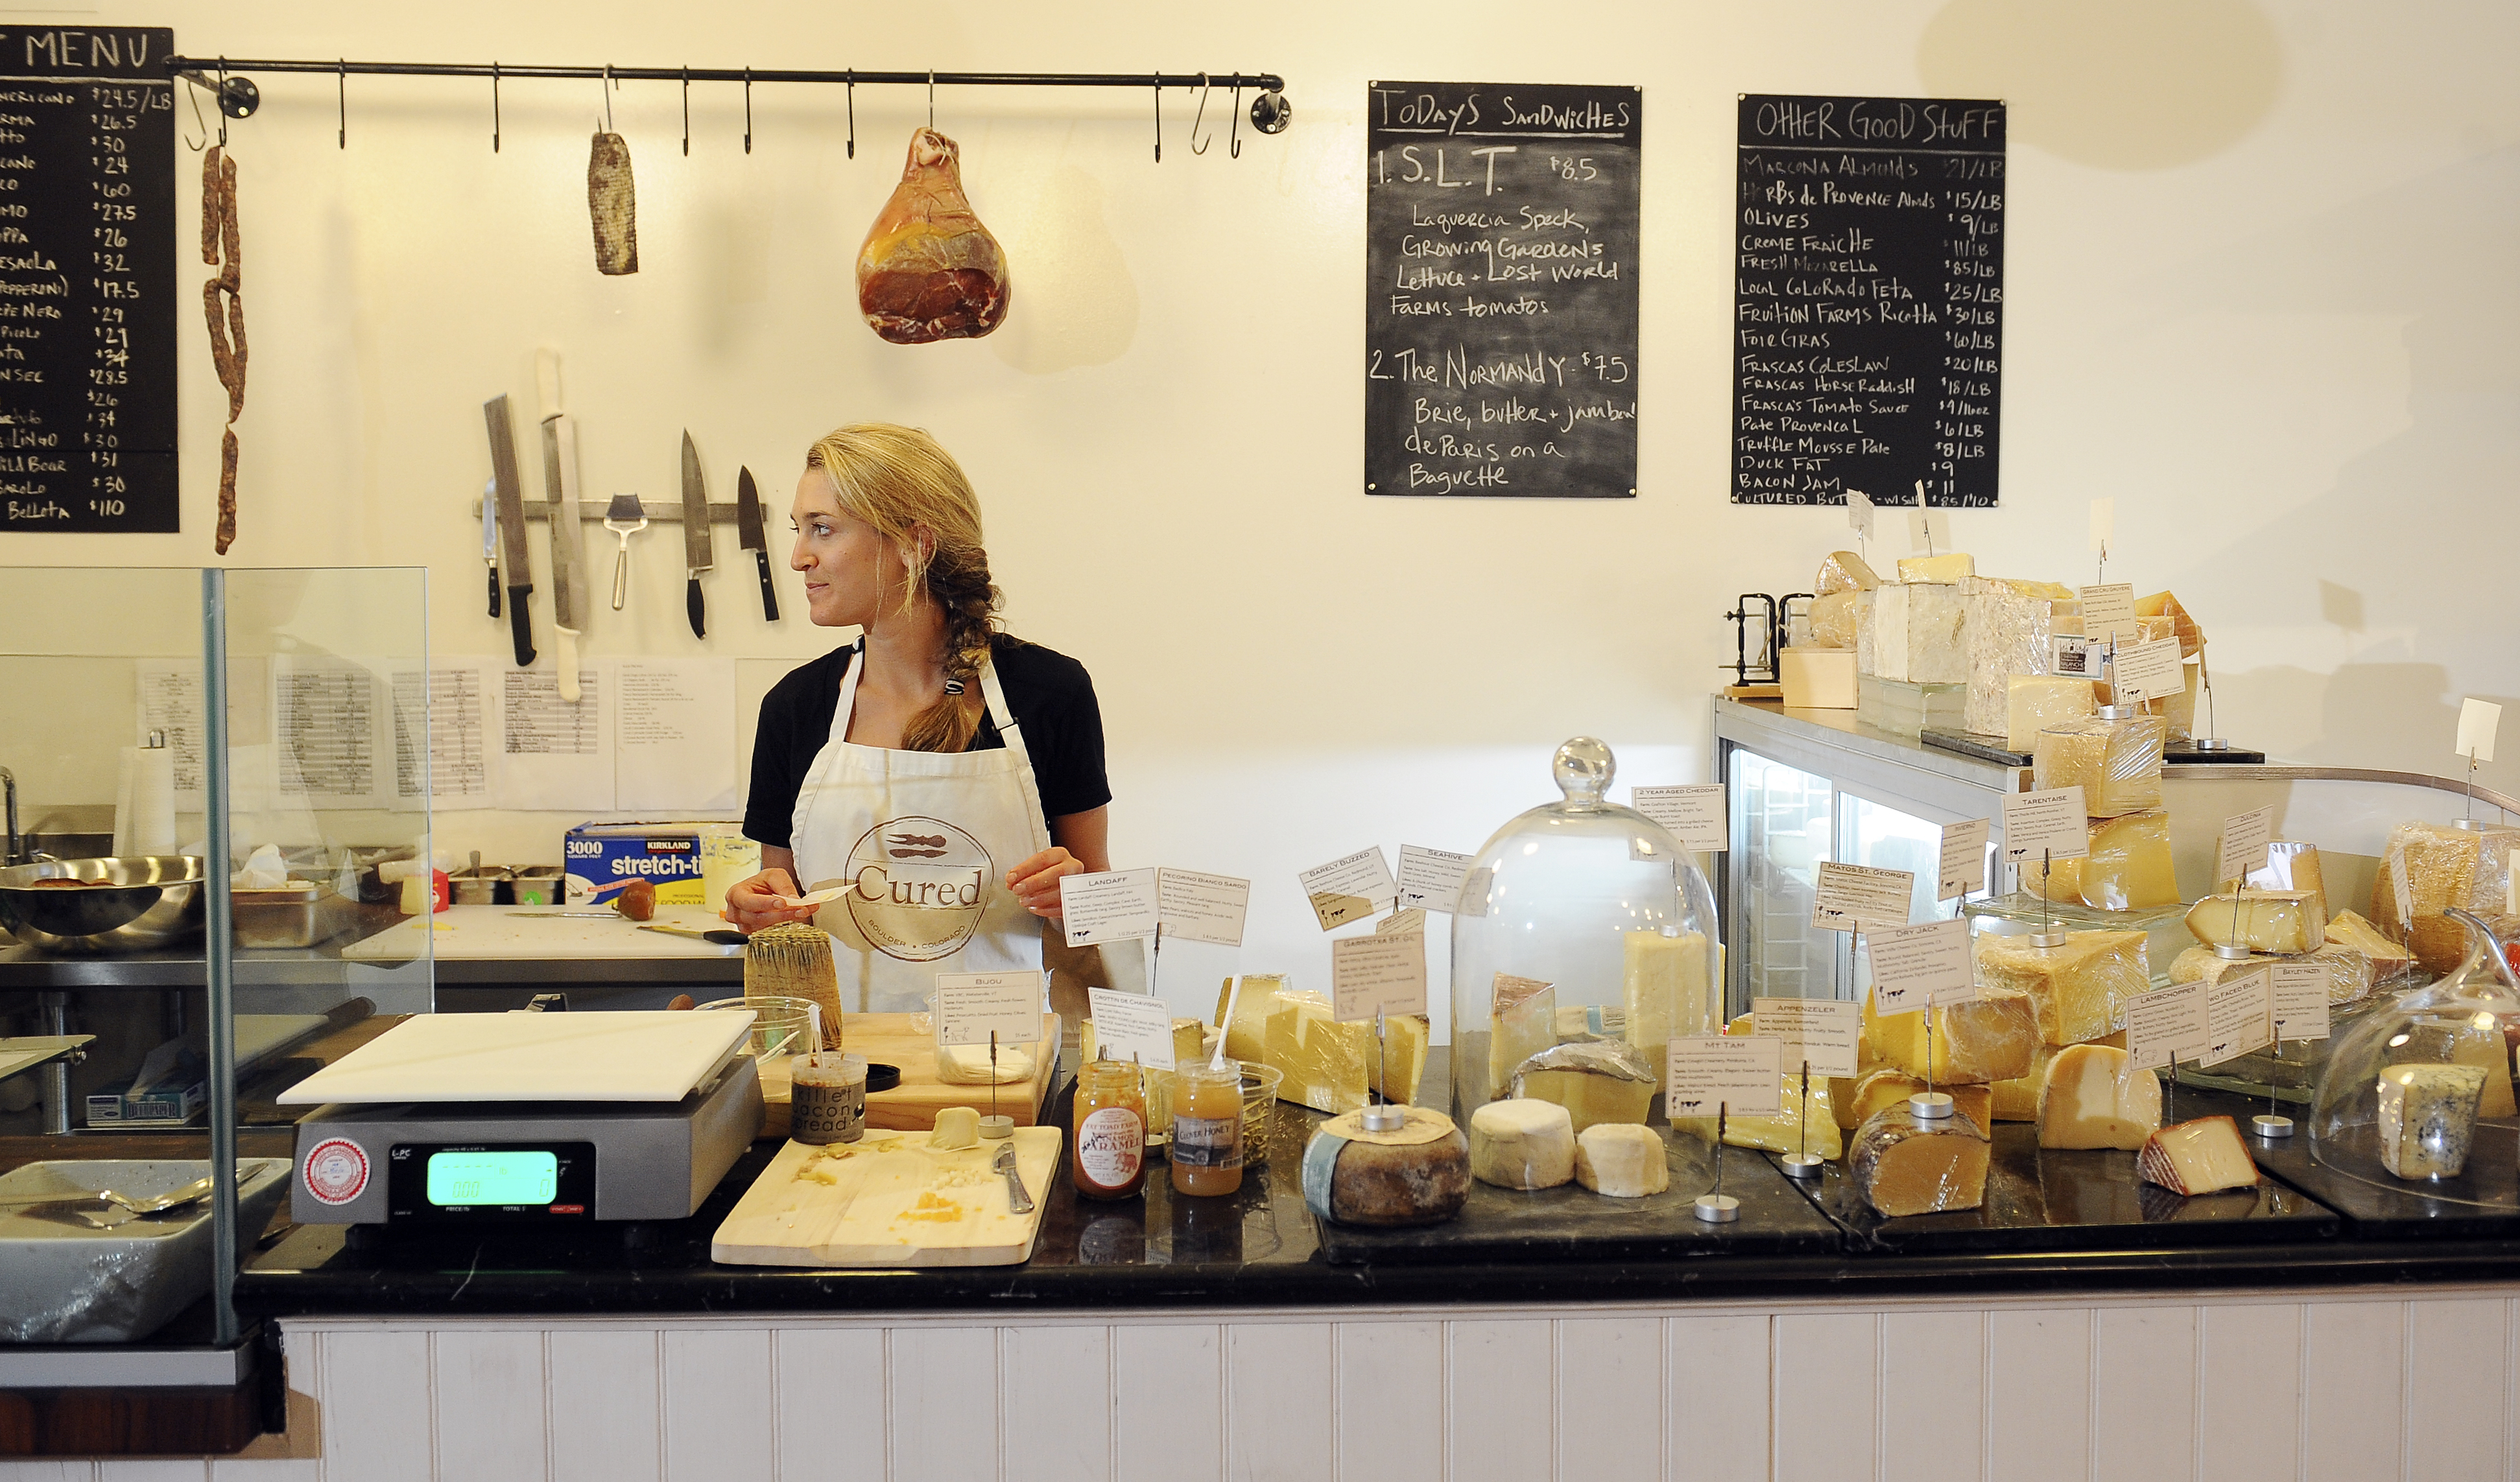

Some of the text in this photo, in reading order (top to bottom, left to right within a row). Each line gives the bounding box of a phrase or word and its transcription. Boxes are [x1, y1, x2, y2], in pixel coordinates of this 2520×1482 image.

[26, 31, 147, 67] MENU
[92, 87, 171, 113] $24.5/LB
[91, 114, 136, 129] $26.5
[1757, 101, 1841, 140] OTHER
[1848, 101, 1916, 139] GOOD
[91, 136, 125, 153] $30
[93, 157, 128, 174] $24
[1550, 156, 1597, 181] $8.5
[93, 182, 130, 198] $60
[1946, 190, 2002, 211] $15/LB
[93, 202, 136, 221] $27.5
[1744, 207, 1999, 241] OLIVES $9/LB
[94, 228, 128, 248] $26
[1803, 227, 1875, 253] FRAICHE
[94, 252, 130, 272] $32
[94, 277, 139, 298] $17.5
[1739, 277, 1779, 297] LOCAL
[1945, 281, 2003, 303] $25/LB
[92, 307, 123, 323] $29
[1816, 302, 1872, 325] FARMS
[1946, 304, 1995, 325] $30/LB
[1781, 329, 1830, 349] GRAS
[1946, 330, 1995, 349] $60/LB
[1370, 349, 1394, 380] 2.
[1395, 347, 1438, 382] The
[1581, 351, 1628, 384] $7.5
[1742, 353, 1998, 374] FRASCAS COLESLAW $20/LB
[89, 369, 128, 385] $28.5
[1742, 375, 1805, 392] FRASCAS
[1942, 377, 1991, 397] $18/LB
[88, 390, 119, 406] $26
[1742, 394, 1801, 412] FRASCA'S
[1807, 397, 1862, 414] TOMATO
[1482, 396, 1547, 424] butter
[1935, 420, 1984, 438] $6/LB
[84, 432, 119, 448] $30
[1510, 444, 1536, 458] on
[1543, 441, 1565, 458] a
[1799, 438, 1856, 454] MOUSSE
[1934, 442, 1985, 459] $8/LB
[91, 452, 117, 467] $31
[1741, 456, 1954, 477] DUCK FAT $9
[92, 476, 126, 493] $30
[1409, 463, 1509, 495] Baguette
[1739, 473, 1794, 489] BACON
[1802, 475, 1840, 491] JAM
[1736, 492, 1806, 504] CULTURED
[90, 500, 125, 517] $110
[2022, 795, 2067, 805] TARENTAISE
[566, 841, 691, 854] 3000 KIRKLAND
[1428, 850, 1463, 861] SEAHIVE
[1309, 852, 1370, 877] BARELY BUZZED
[1828, 864, 1857, 873] MATOS
[1873, 869, 1907, 879] GEORGE
[854, 865, 982, 906] Cured
[1088, 876, 1128, 887] LANDAFF
[1163, 872, 1197, 882] PECORINO
[868, 919, 965, 949] BOULDER COLORADO
[1916, 926, 1940, 935] JACK
[2141, 986, 2196, 1004] LAMBCHOPPER
[1204, 1125, 1230, 1137] HONEY
